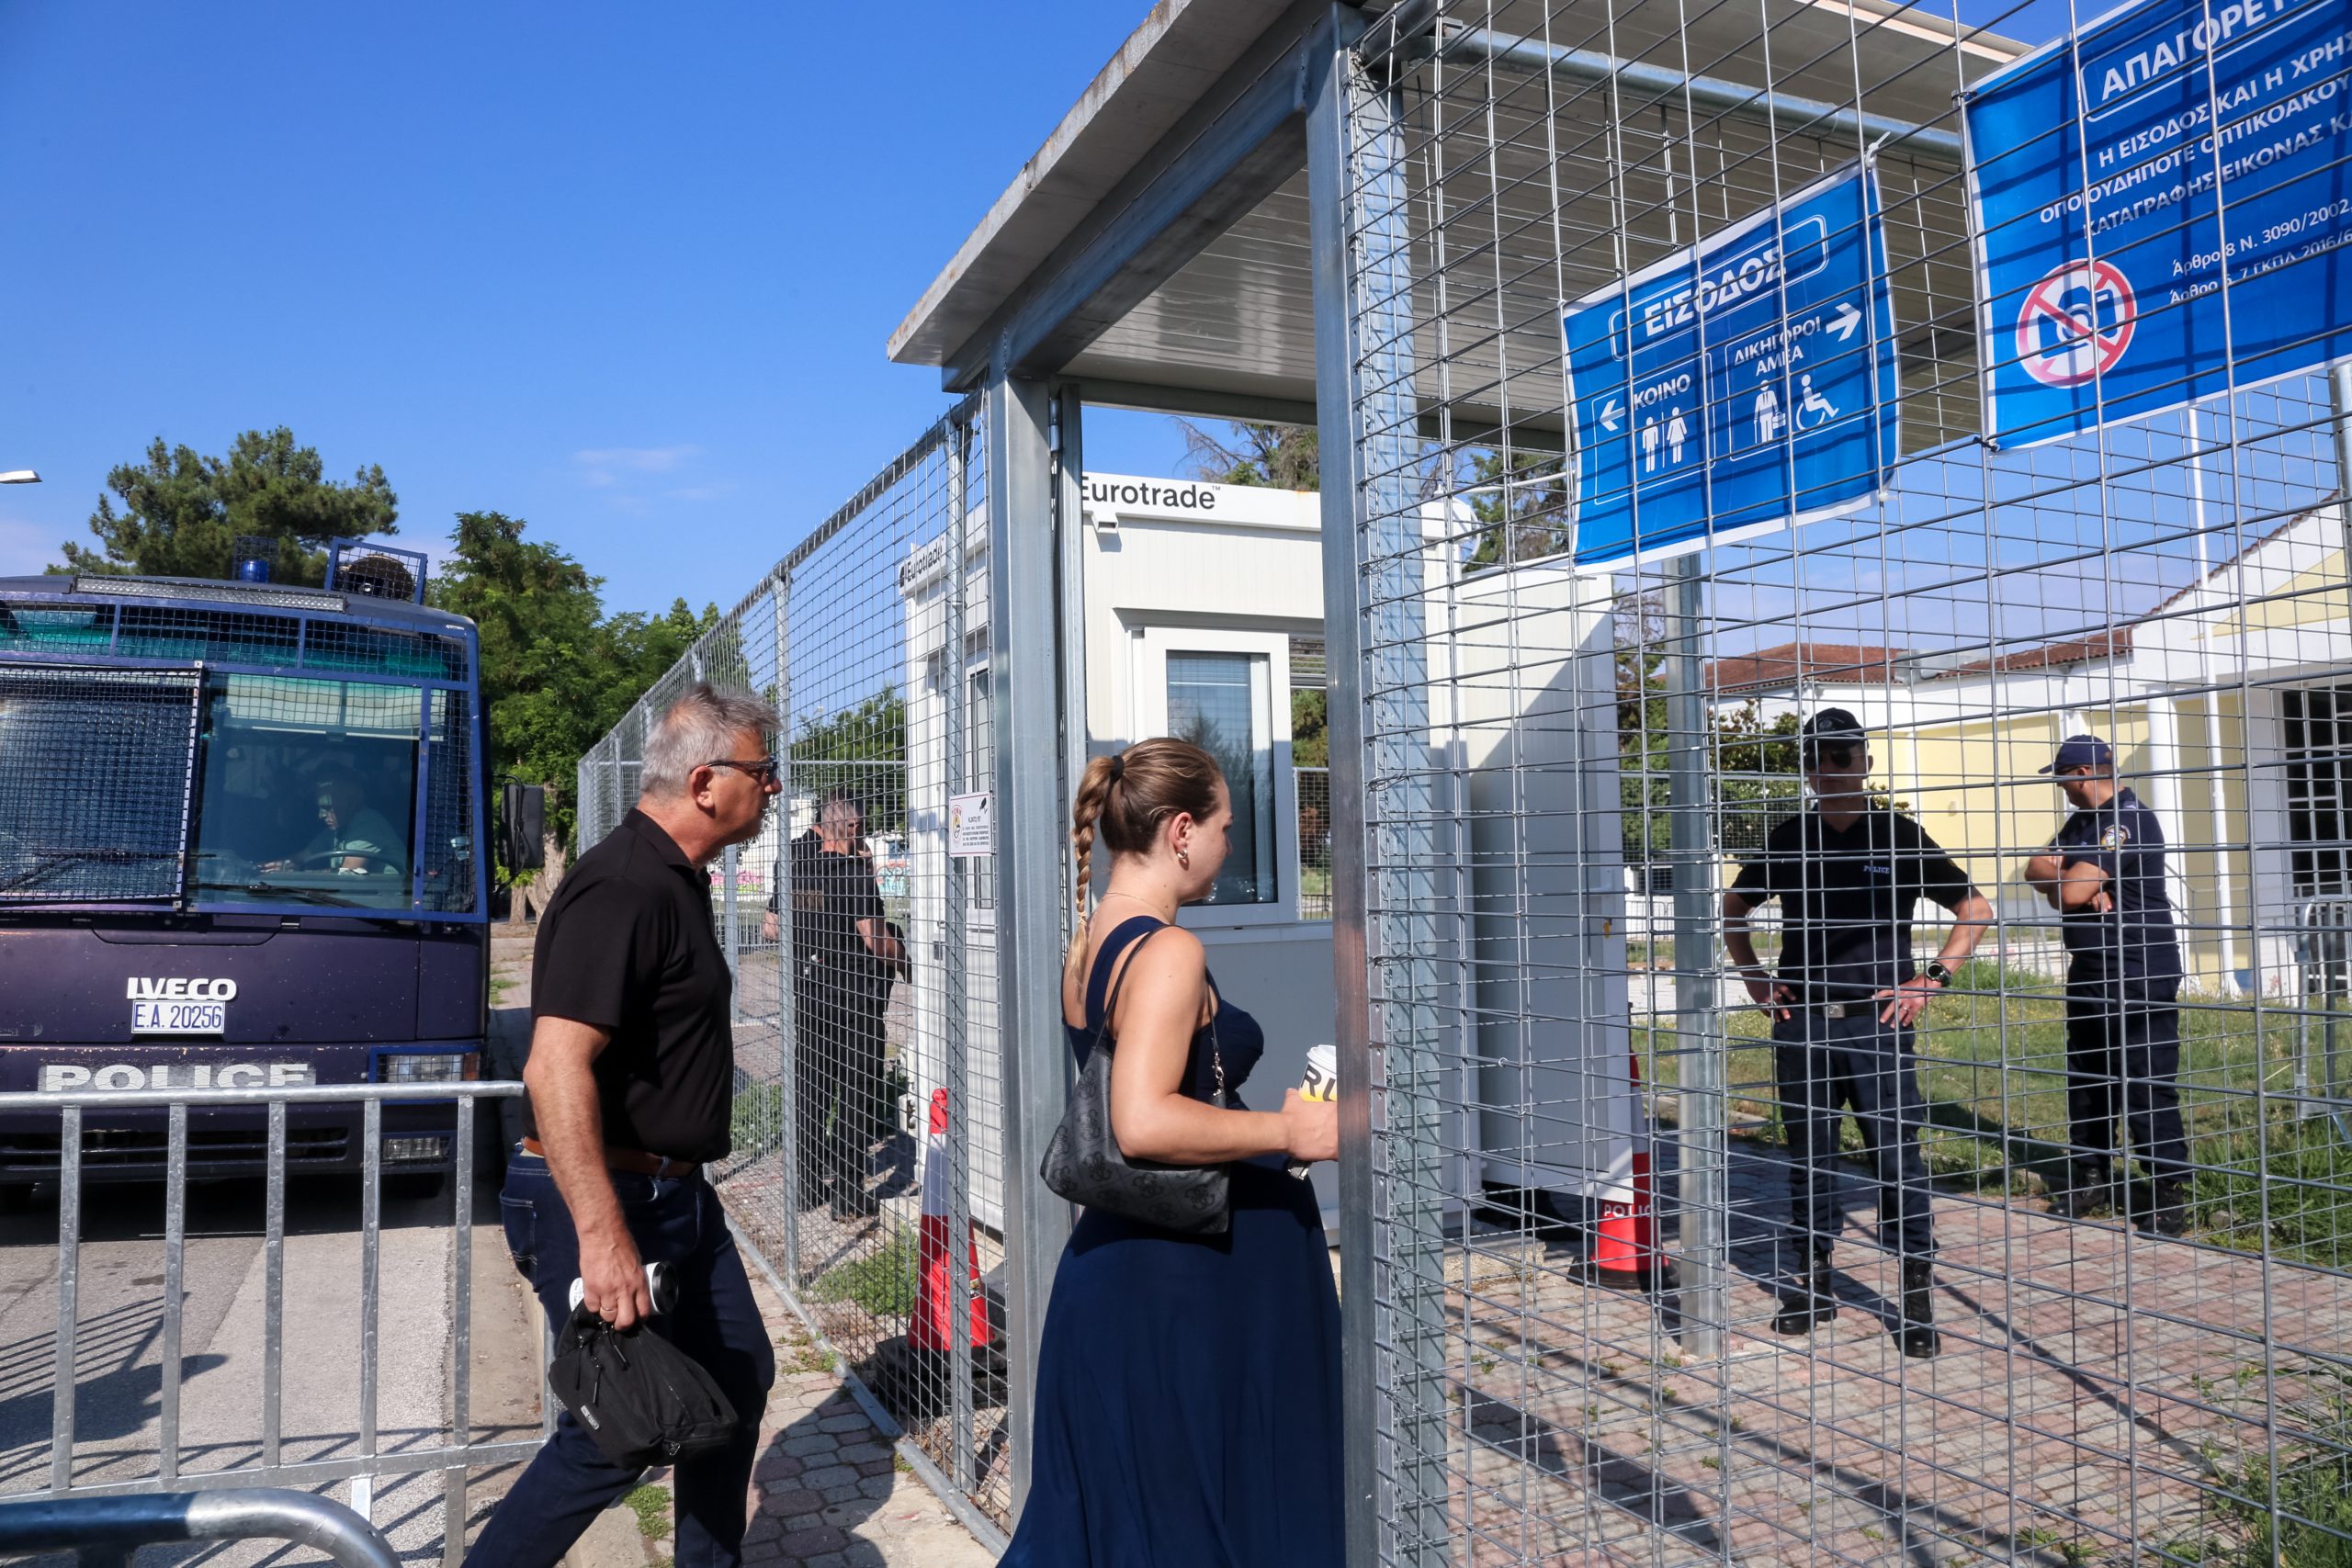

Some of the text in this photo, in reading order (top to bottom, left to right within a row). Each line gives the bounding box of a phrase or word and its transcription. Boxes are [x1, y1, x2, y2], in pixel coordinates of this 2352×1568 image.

[2098, 147, 2114, 168] Η
[2119, 103, 2211, 159] ΕΙΣΟΔΟΣ
[2216, 80, 2258, 114] ΚΑΙ
[2265, 66, 2284, 91] Η
[2083, 171, 2216, 240] ΚΑΤΑΓΡΑΦΗΣ
[2222, 123, 2324, 183] ΕΙΚΟΝΑΣ
[2172, 251, 2222, 276] Άρθρο
[2225, 243, 2236, 256] 8
[2240, 235, 2258, 252] Ν.
[1644, 244, 1787, 337] ΕΙΣΟΔΟΣ
[1735, 315, 1821, 366] ΔΙΚΗΓΟΡΟΙ
[1633, 373, 1690, 411] ΚΟΙΝΟ
[126, 976, 237, 1001] IVECO
[169, 1005, 222, 1029] 20256
[1604, 1204, 1657, 1218] POLIC
